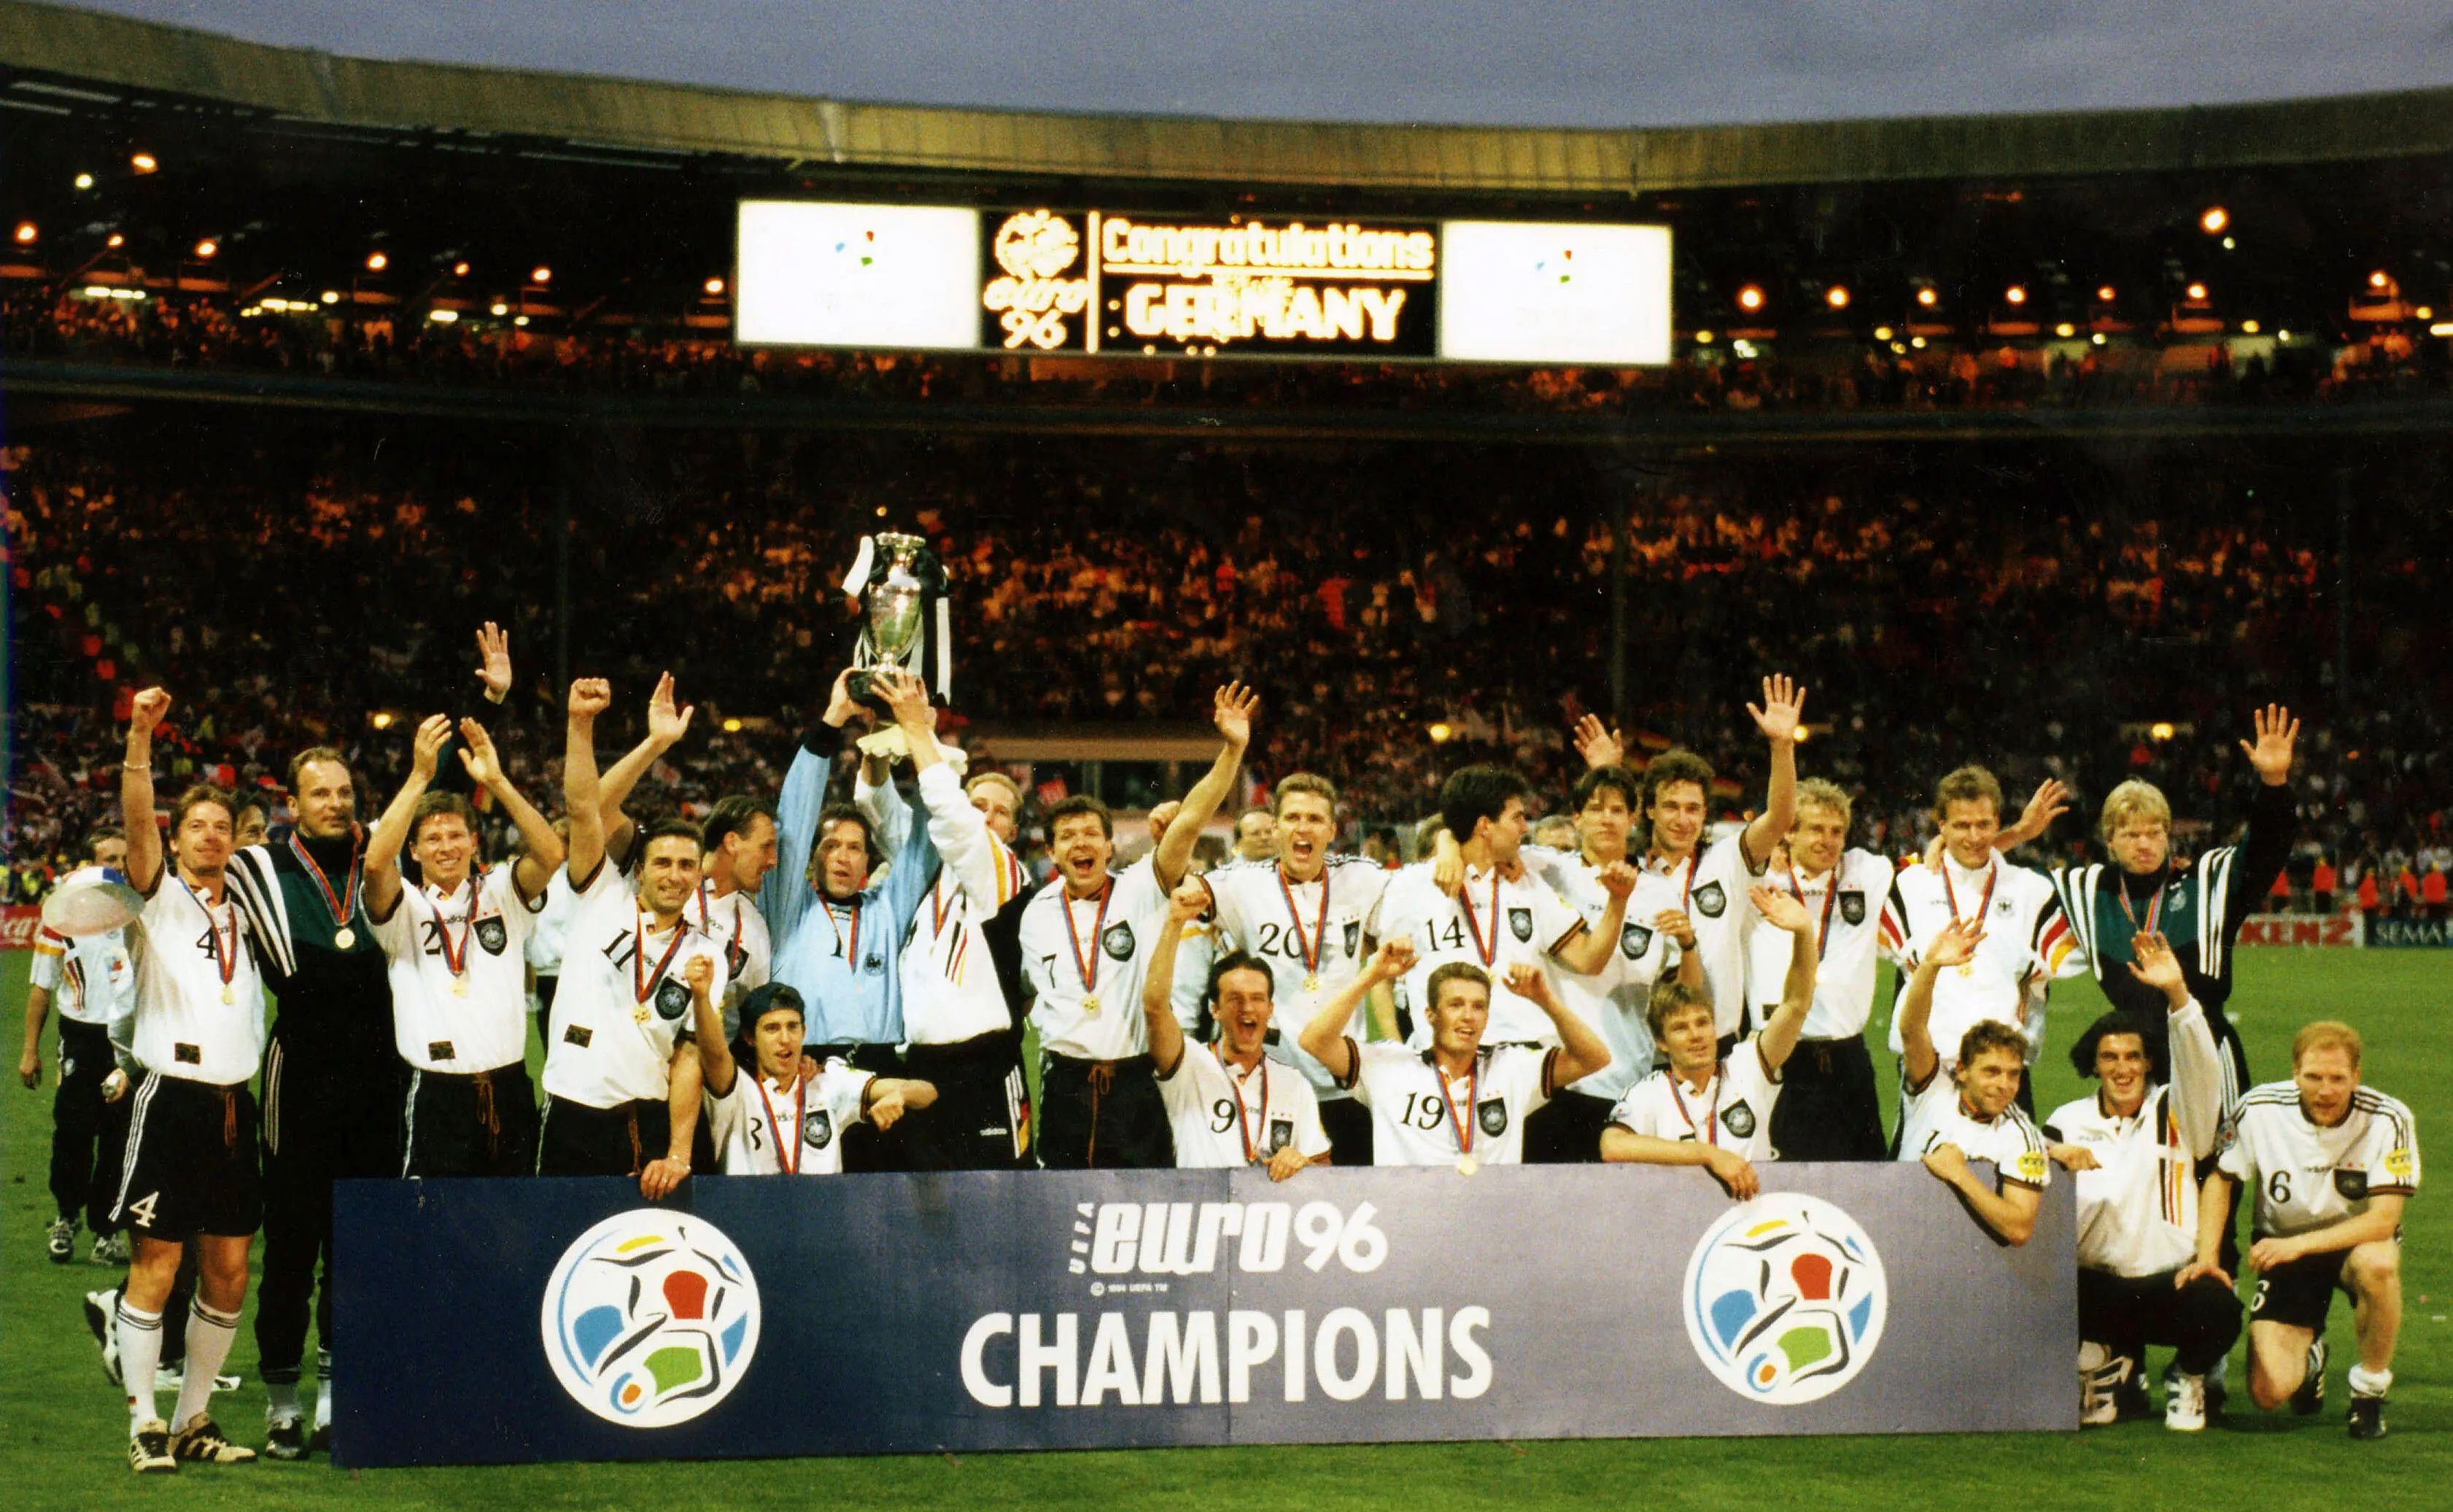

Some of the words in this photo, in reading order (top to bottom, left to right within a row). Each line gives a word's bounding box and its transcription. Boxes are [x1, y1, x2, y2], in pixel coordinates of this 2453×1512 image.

[1102, 218, 1434, 278] Congratulations
[1001, 309, 1068, 349] 96
[1125, 283, 1406, 341] GERMANY
[196, 926, 217, 960] 4
[1259, 922, 1303, 959] 20
[1426, 915, 1465, 951] 14
[1042, 953, 1057, 989] 7
[1211, 1098, 1236, 1133] 9
[1400, 1092, 1445, 1131] 19
[750, 1117, 763, 1151] 3
[2269, 1170, 2291, 1203] 6
[129, 1190, 159, 1228] 4
[961, 1306, 1494, 1407] CHAMPIONS
